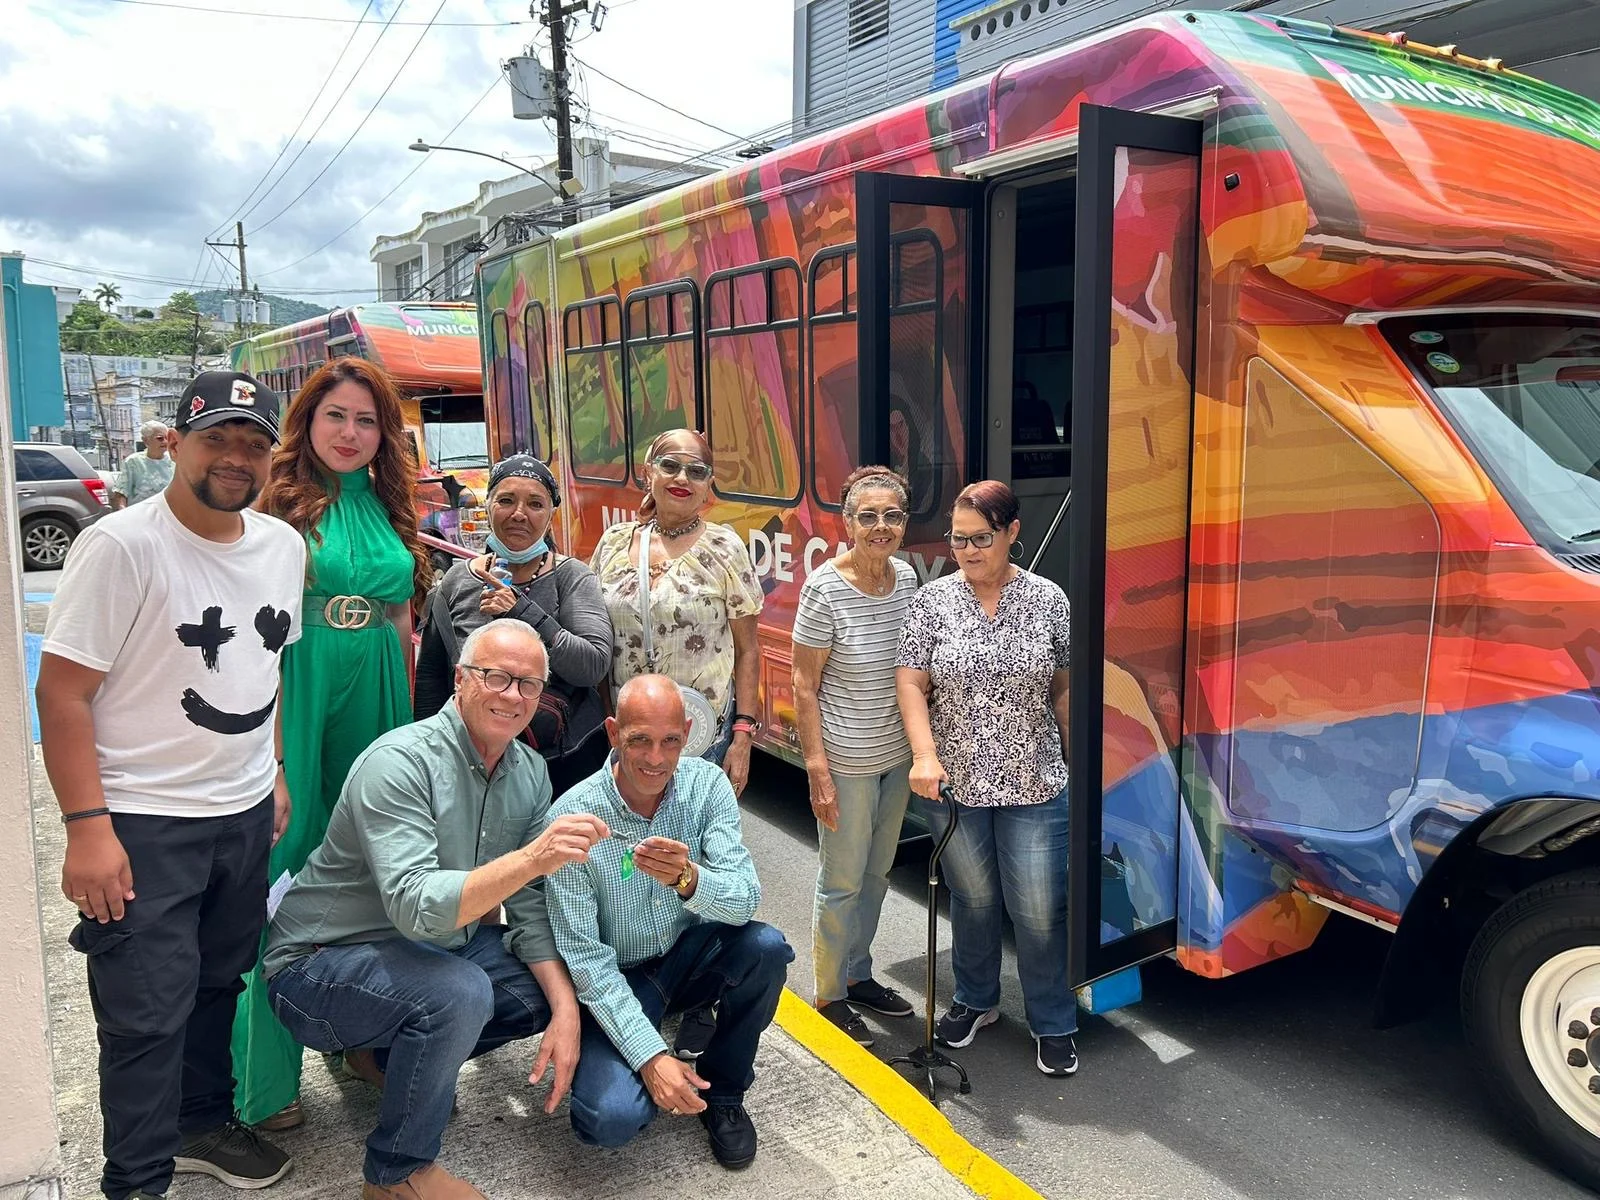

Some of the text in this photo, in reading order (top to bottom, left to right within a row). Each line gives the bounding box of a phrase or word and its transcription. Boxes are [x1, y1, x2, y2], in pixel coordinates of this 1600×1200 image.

[1337, 73, 1527, 117] MUNICIPIO
[405, 323, 477, 336] MUNICI
[748, 528, 794, 583] DE
